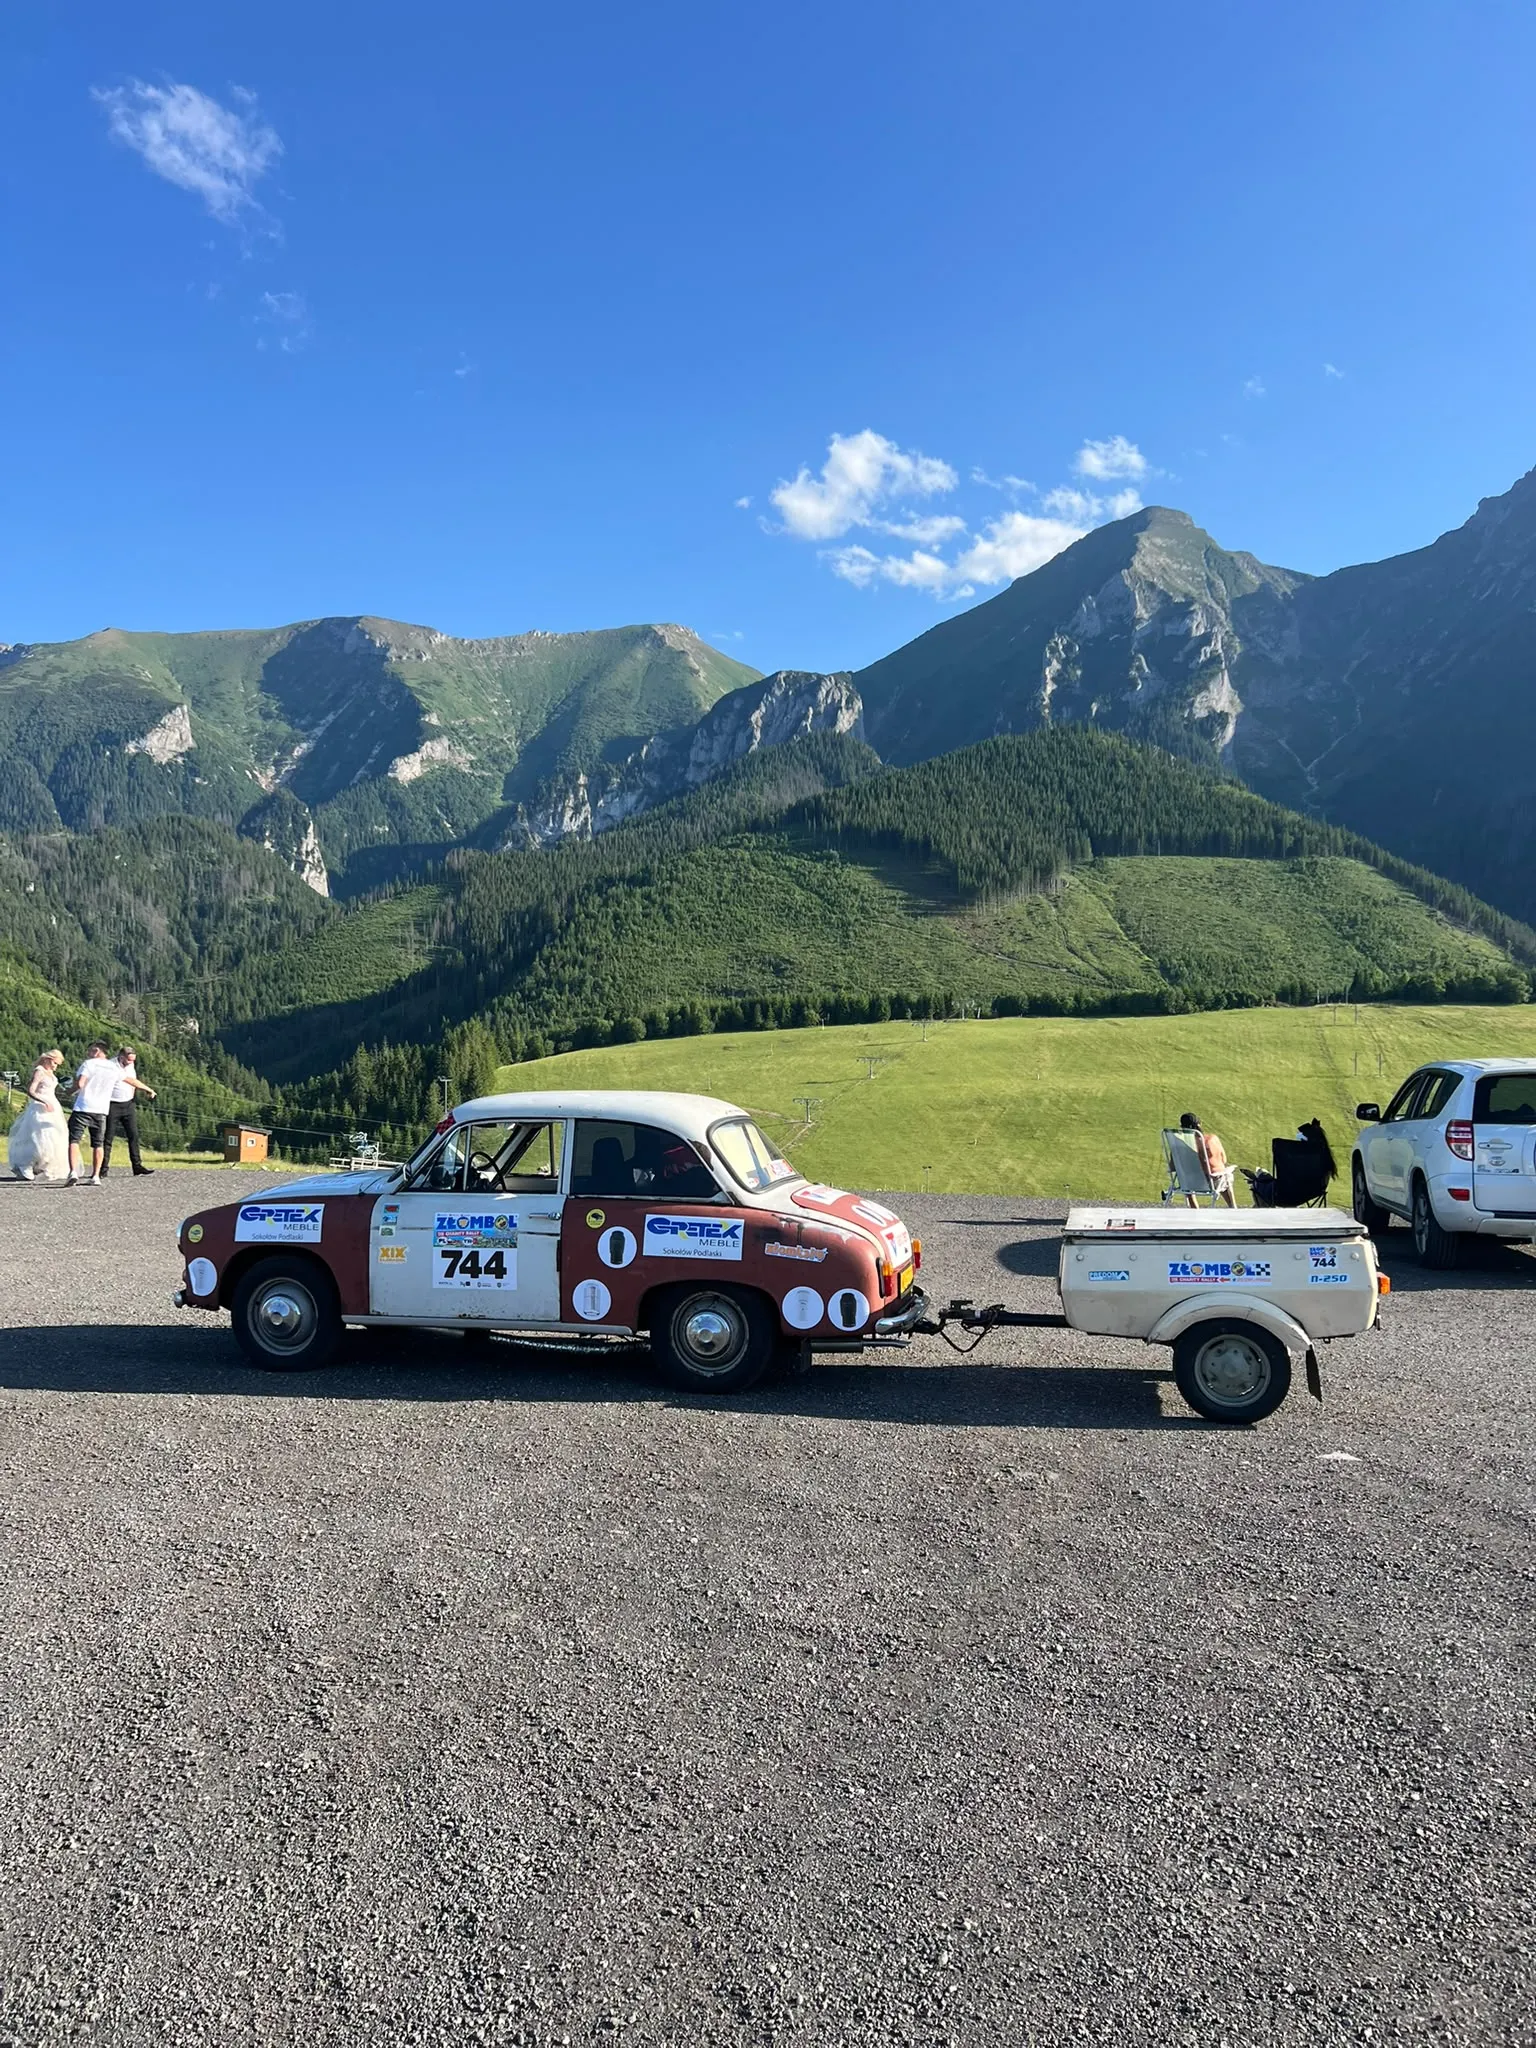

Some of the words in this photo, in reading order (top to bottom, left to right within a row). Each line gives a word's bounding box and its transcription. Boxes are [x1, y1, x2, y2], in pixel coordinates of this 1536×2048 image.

[283, 1223, 319, 1231] MEBLE
[699, 1238, 740, 1248] MEBLE
[380, 1247, 407, 1258] XIX
[693, 1248, 722, 1257] Podlaski
[441, 1250, 507, 1279] 744
[1312, 1257, 1336, 1267] 744
